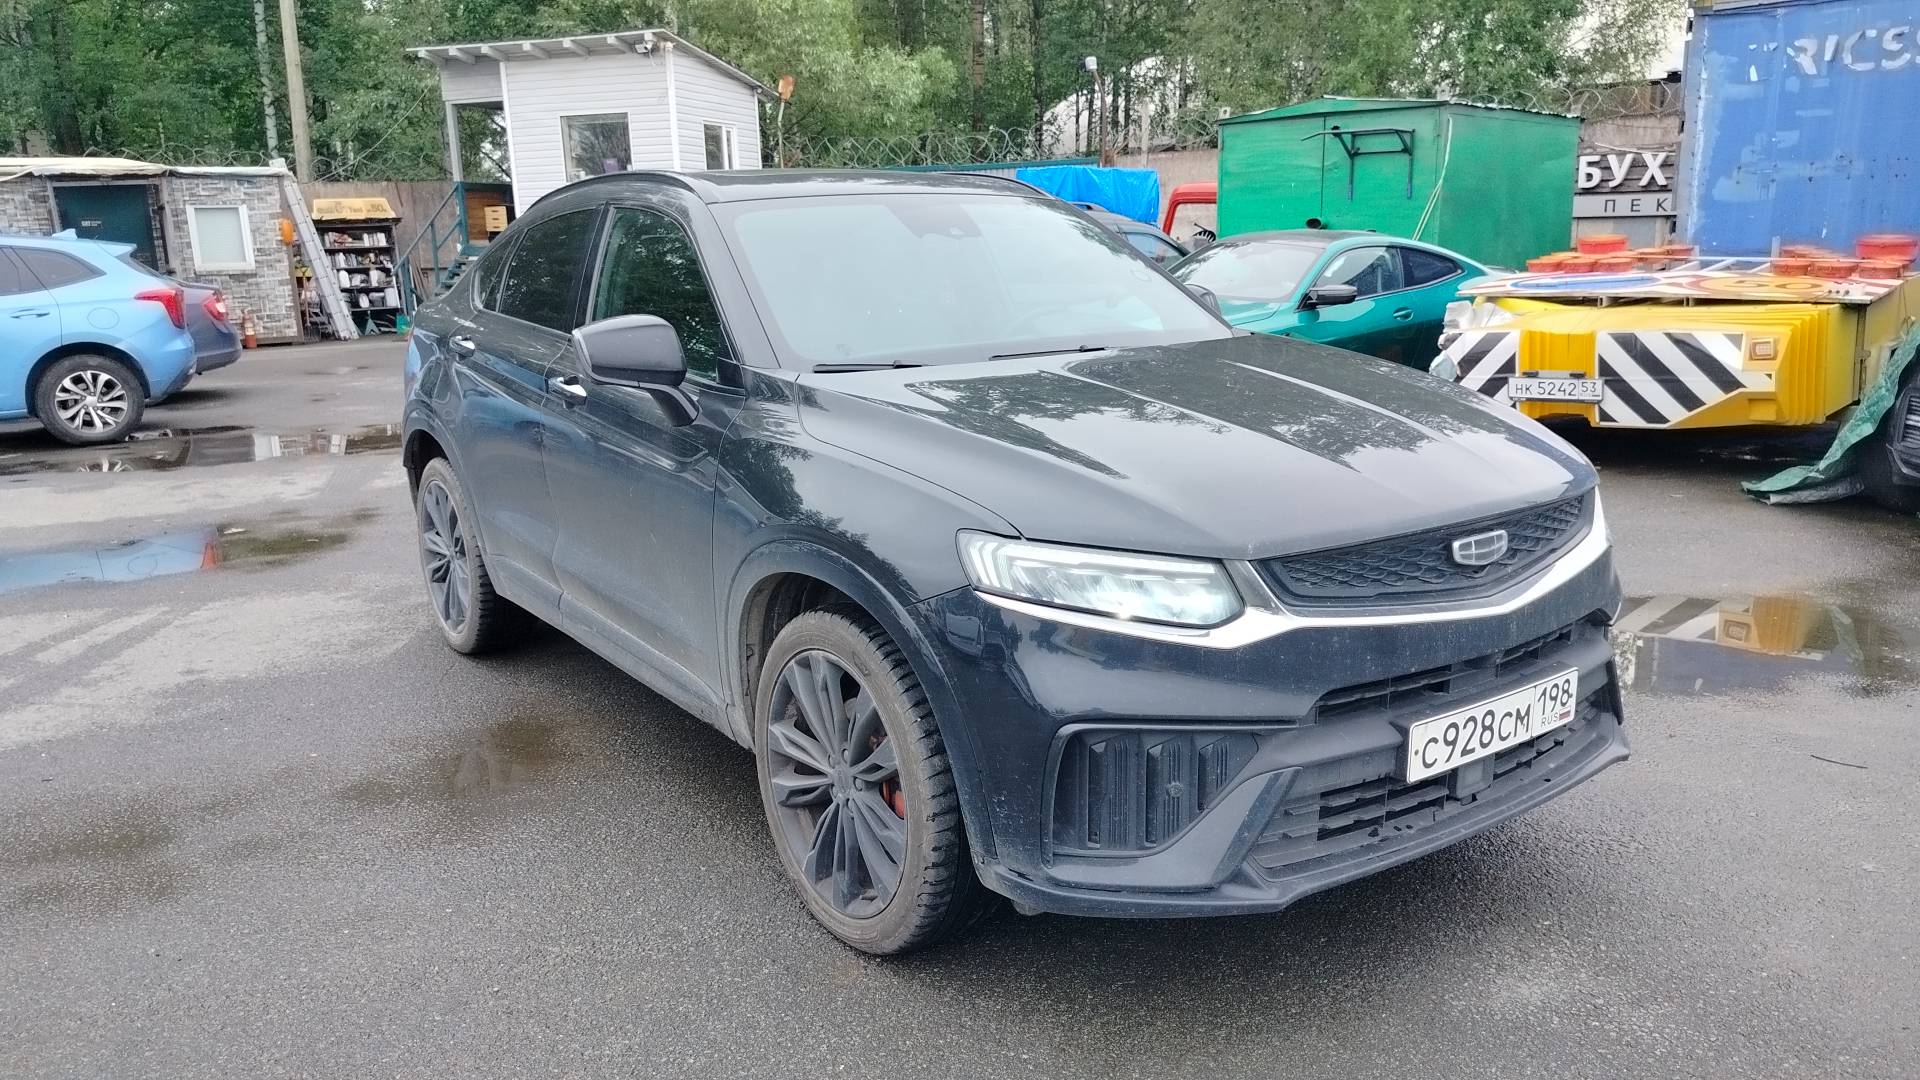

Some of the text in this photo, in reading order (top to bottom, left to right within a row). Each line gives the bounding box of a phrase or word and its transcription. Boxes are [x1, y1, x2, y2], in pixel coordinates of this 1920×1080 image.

[1578, 152, 1668, 189] БУХ
[1604, 198, 1668, 213] ПЕК
[1537, 381, 1577, 397] 5242
[1581, 381, 1597, 393] 53
[1421, 678, 1571, 769] С928СМ 198
[1541, 713, 1559, 728] RUS
